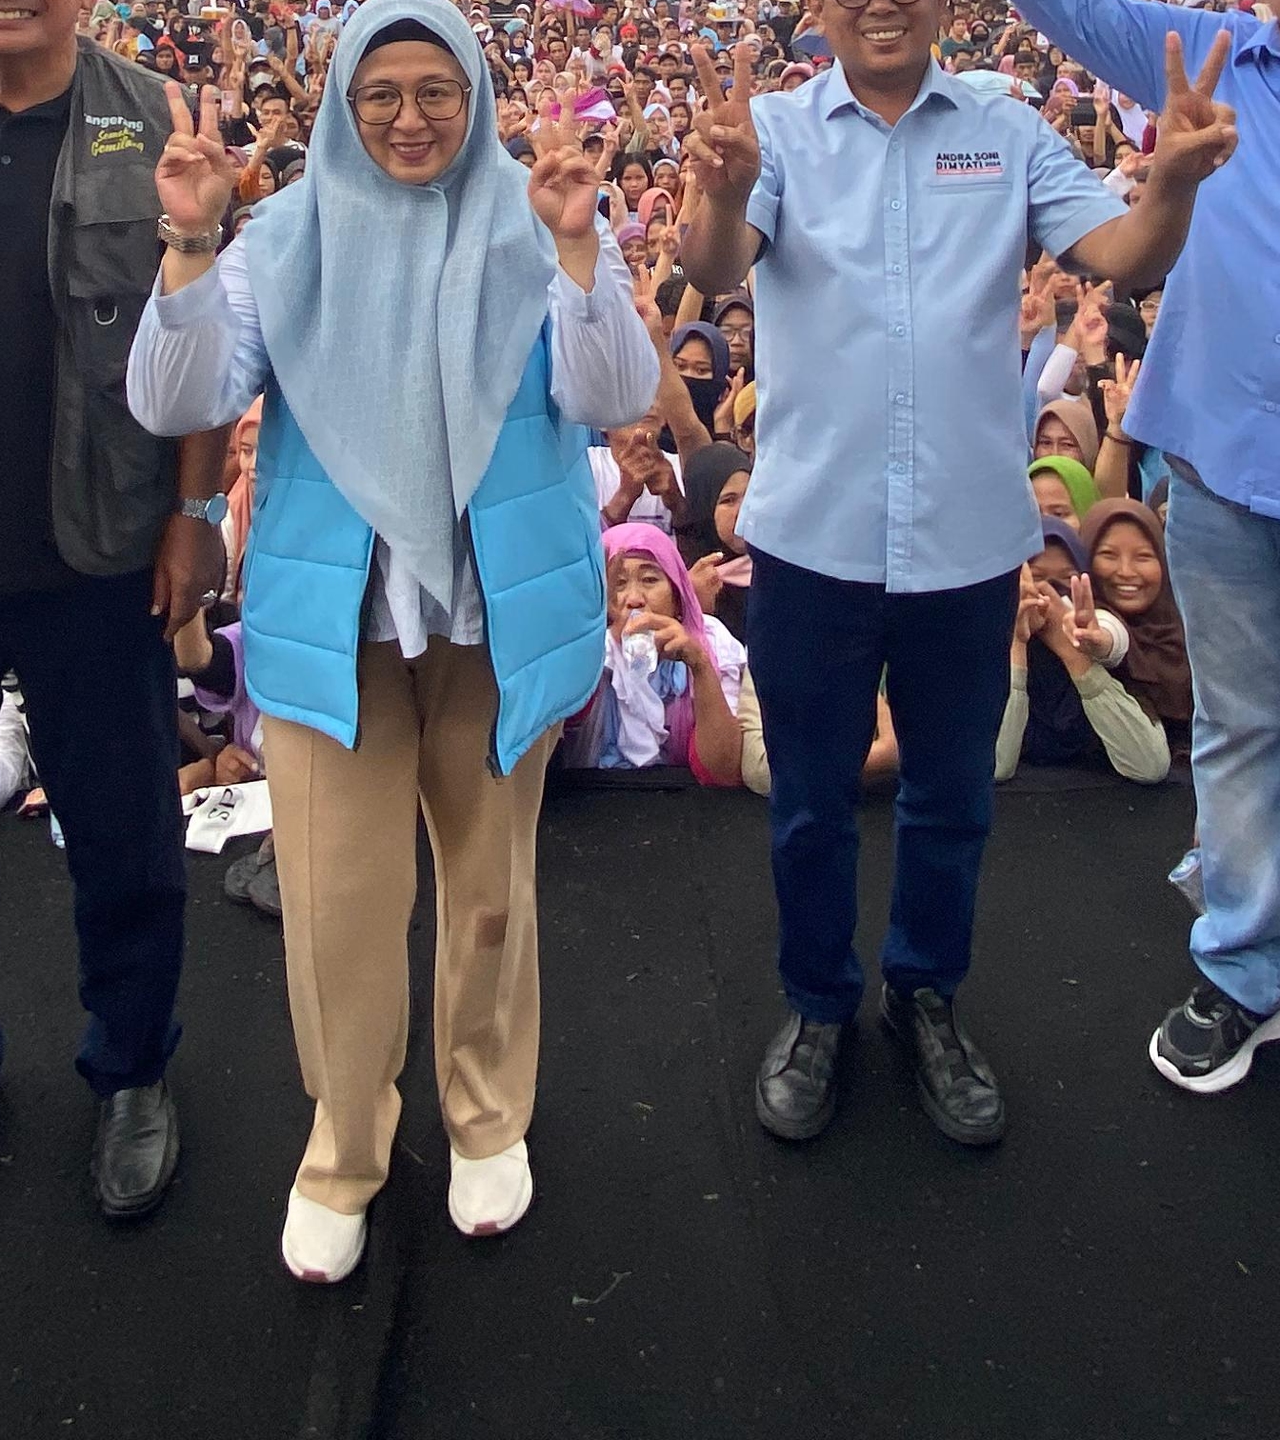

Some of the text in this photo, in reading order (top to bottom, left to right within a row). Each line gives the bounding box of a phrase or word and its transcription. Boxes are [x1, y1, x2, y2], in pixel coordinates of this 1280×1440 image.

[84, 113, 144, 132] angerang
[936, 151, 1000, 161] ANDRA SONI
[936, 160, 984, 170] DIMYATI
